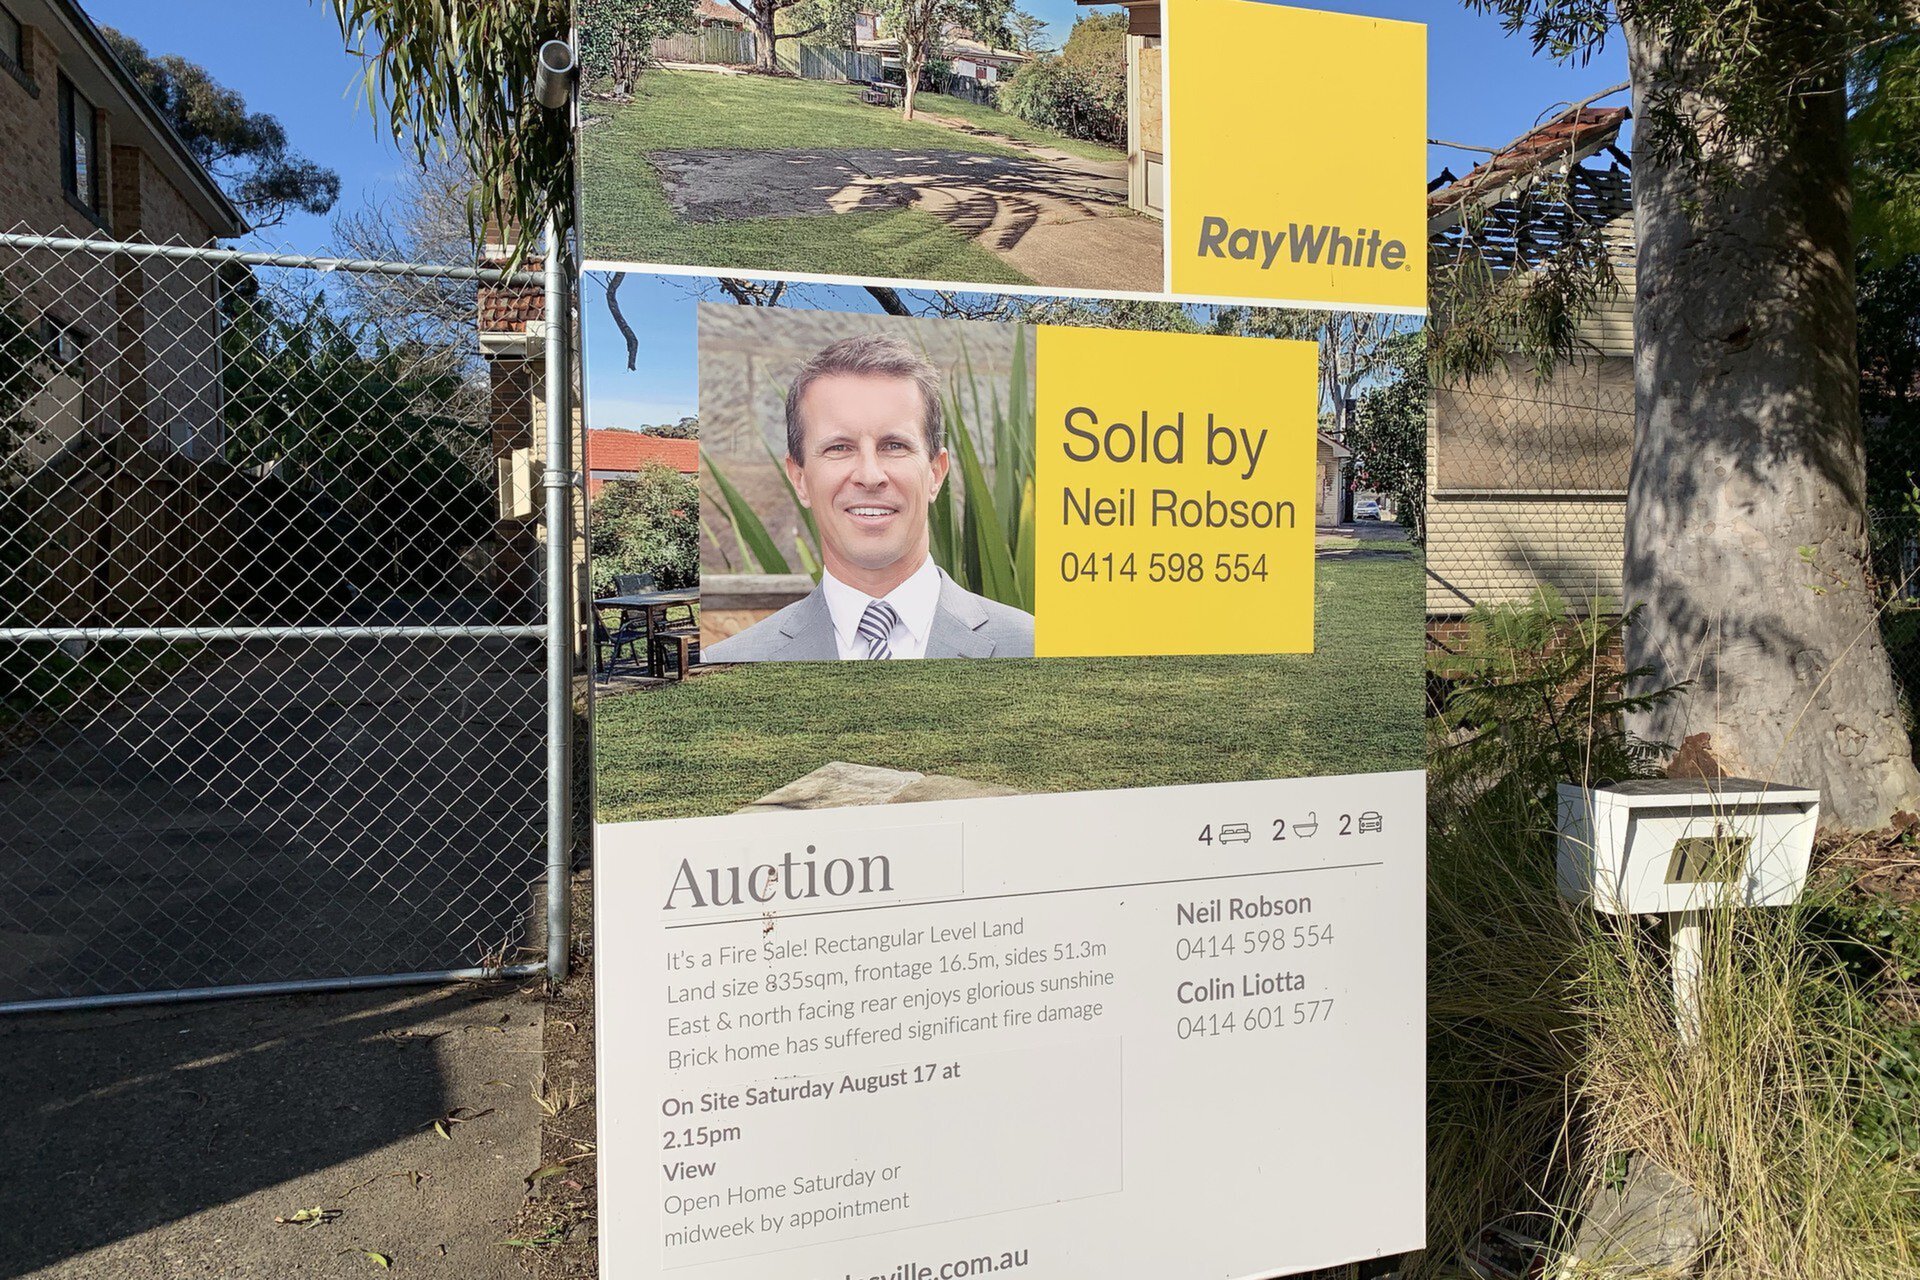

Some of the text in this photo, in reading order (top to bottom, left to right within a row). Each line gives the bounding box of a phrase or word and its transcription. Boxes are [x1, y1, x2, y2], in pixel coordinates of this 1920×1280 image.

[1063, 407, 1268, 480] Sold by
[1064, 487, 1295, 528] Neil Robson
[1061, 552, 1268, 582] 0414 598 554
[1198, 815, 1352, 846] 4 2 2
[663, 845, 894, 909] Auction
[1177, 895, 1311, 925] Neil Robson
[668, 917, 1023, 970] It's a Fire Sale! Rectangular Level Land
[1177, 924, 1334, 961] 0414 598 554
[668, 941, 1106, 1003] Land size 835sqm, frontage 16.5m, sides 51.3m
[1177, 971, 1304, 1004] Colin Liotta
[669, 970, 1113, 1036] East & north facing rear enjoys glorious sunshine
[1178, 999, 1334, 1039] 0414 601 577
[669, 1003, 1102, 1069] Brick home has suffered significant fire damage
[662, 1062, 961, 1117] On Site Saturday August 17 at
[663, 1127, 740, 1150] 2.15pm
[663, 1162, 716, 1181] View
[665, 1166, 901, 1215] Open Home Saturday or
[665, 1193, 909, 1247] midweek by appointment
